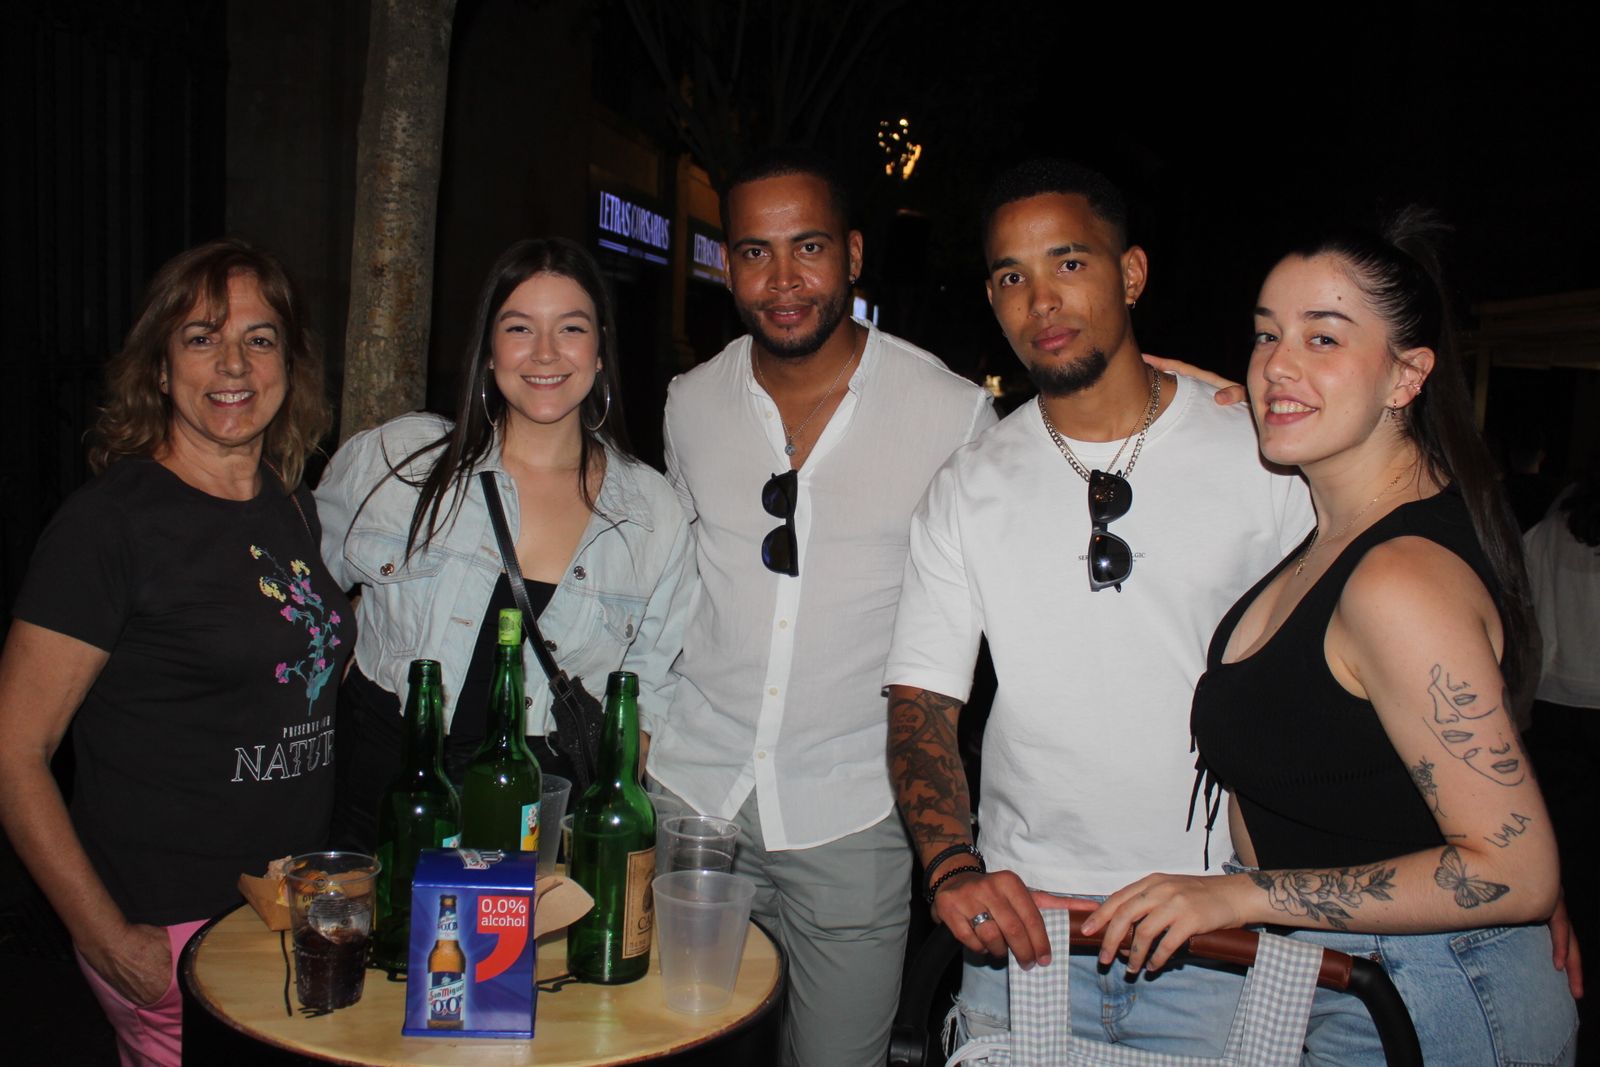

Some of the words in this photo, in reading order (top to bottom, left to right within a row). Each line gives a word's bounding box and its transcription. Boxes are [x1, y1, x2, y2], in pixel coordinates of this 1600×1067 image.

[598, 189, 631, 237] LETRAS
[283, 720, 319, 738] PRESERVE
[481, 898, 526, 914] 0,0%
[481, 914, 526, 927] alcohol
[428, 991, 442, 1003] San
